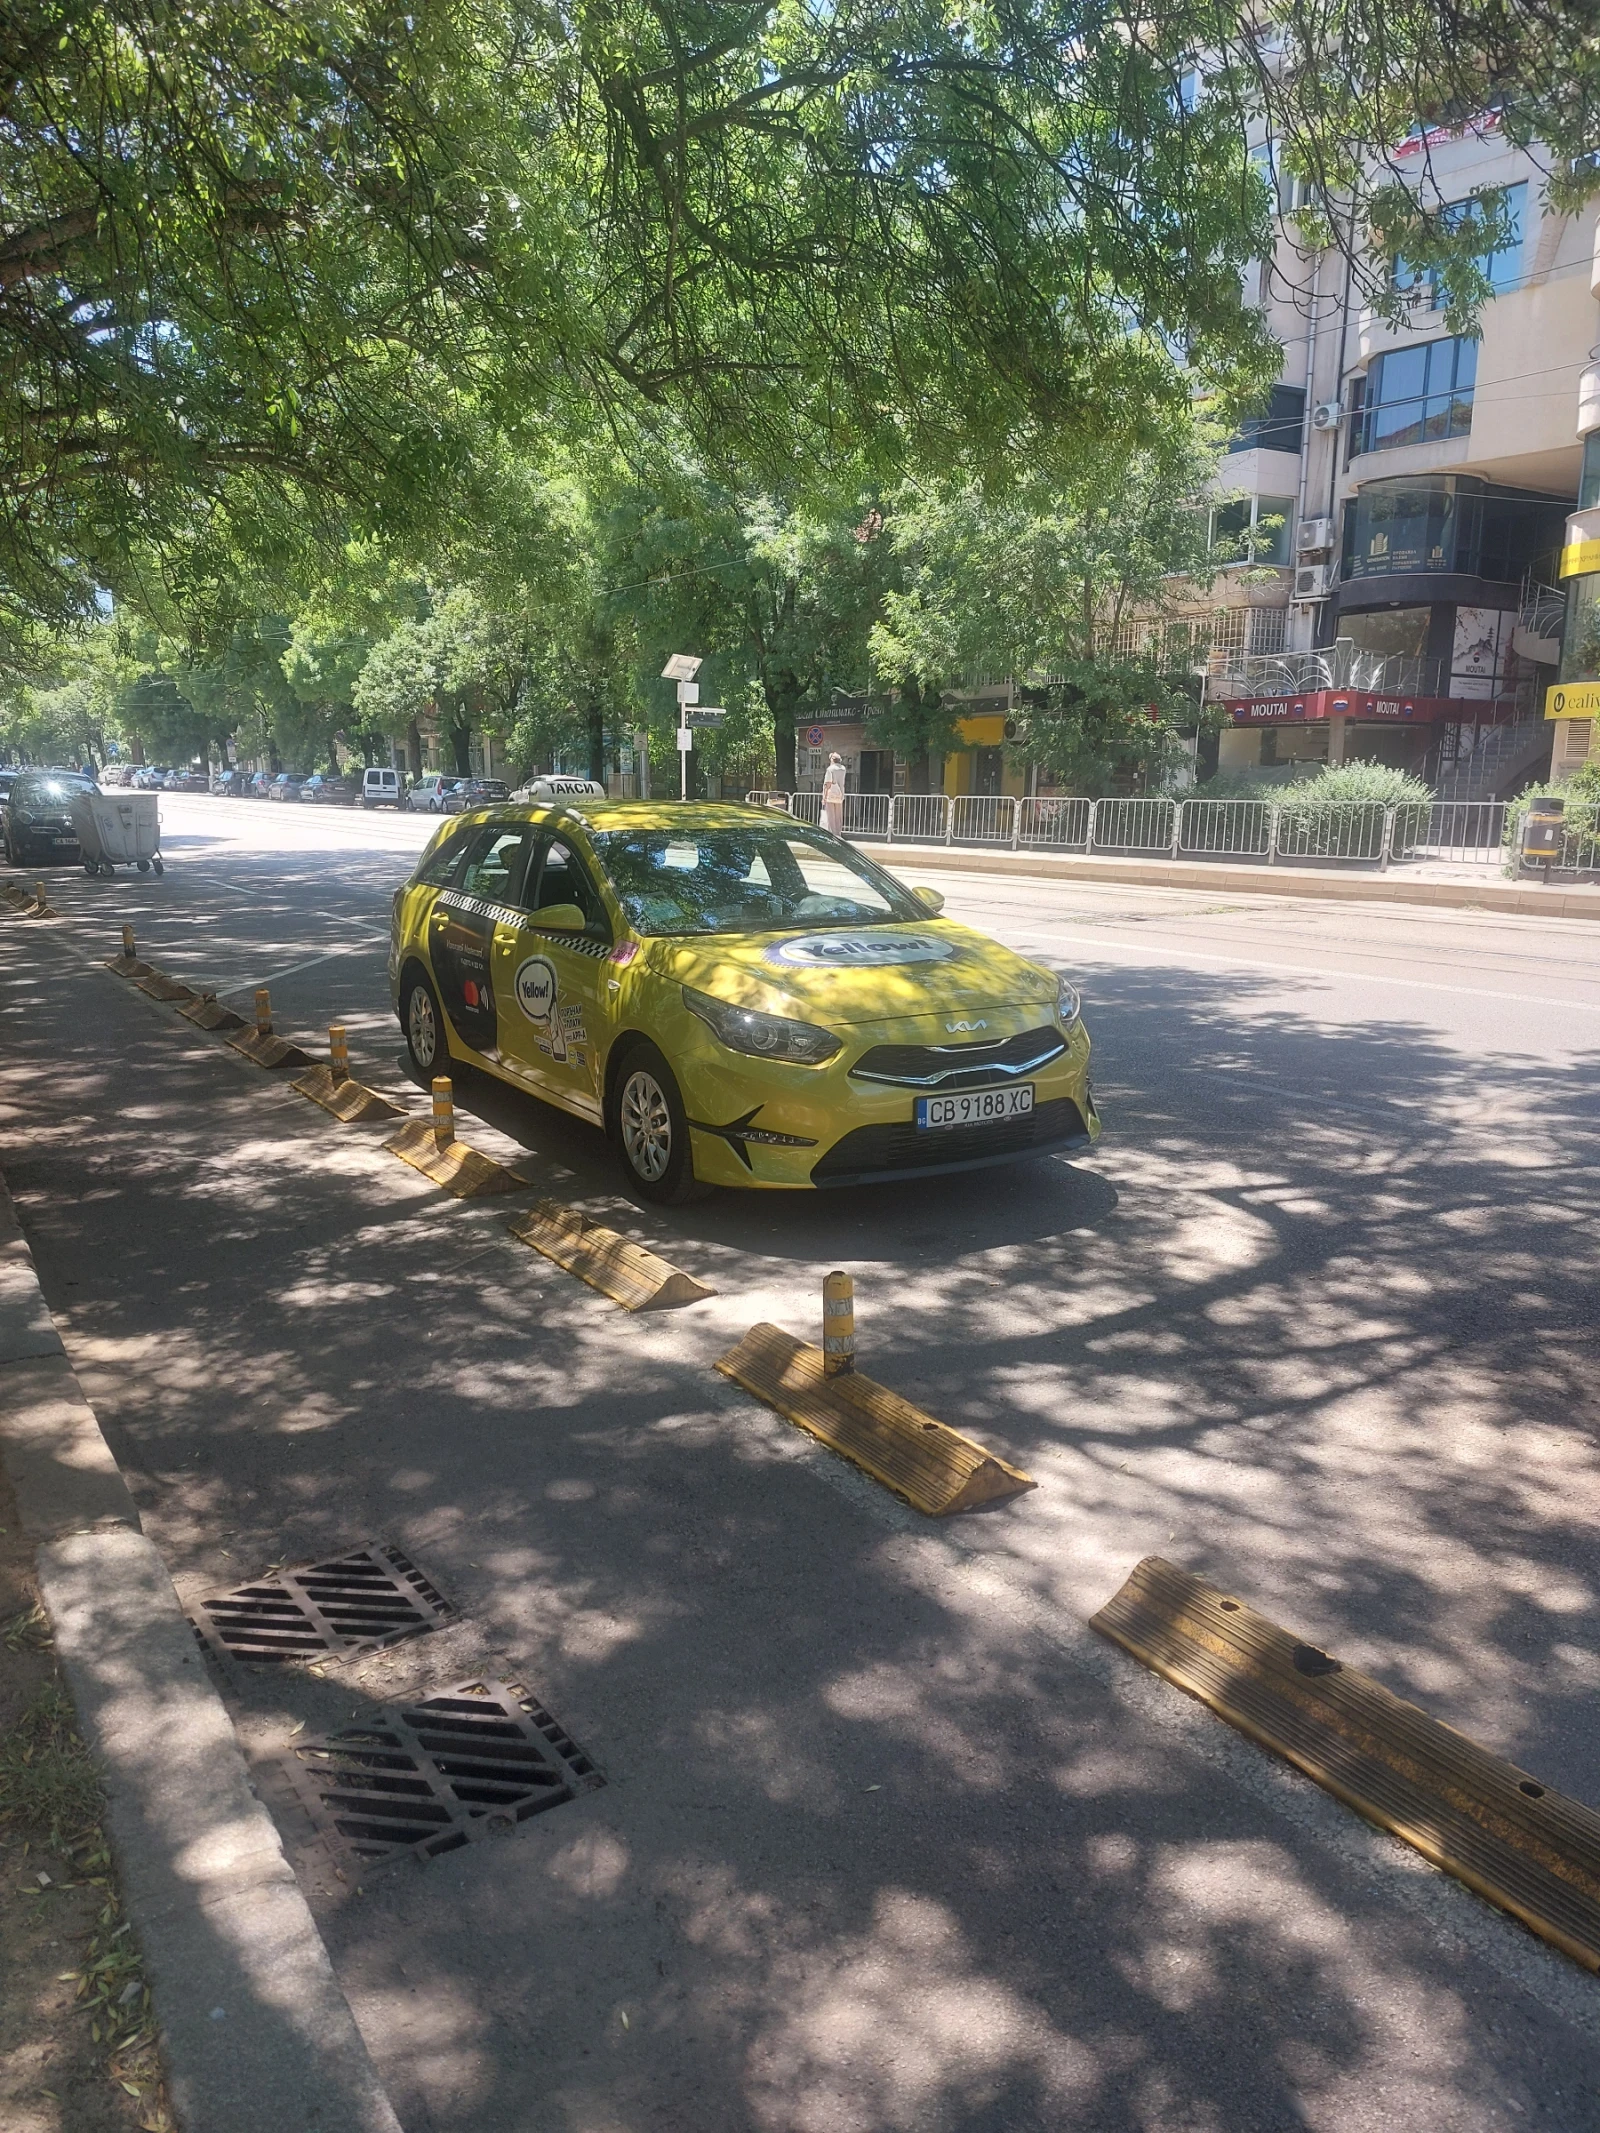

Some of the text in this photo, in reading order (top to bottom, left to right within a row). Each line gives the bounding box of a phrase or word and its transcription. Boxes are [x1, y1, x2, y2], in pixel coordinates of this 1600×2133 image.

[1465, 665, 1486, 674] MOUTAI
[1251, 702, 1288, 717] MOUTAI
[1376, 700, 1400, 715] MOUTAI
[547, 783, 595, 794] ТАКСИ
[798, 939, 934, 957] Yellow!
[522, 980, 549, 998] Yellow!
[946, 1019, 987, 1033] KIA
[931, 1089, 1031, 1123] CB 9188 XC
[917, 1117, 926, 1125] BG
